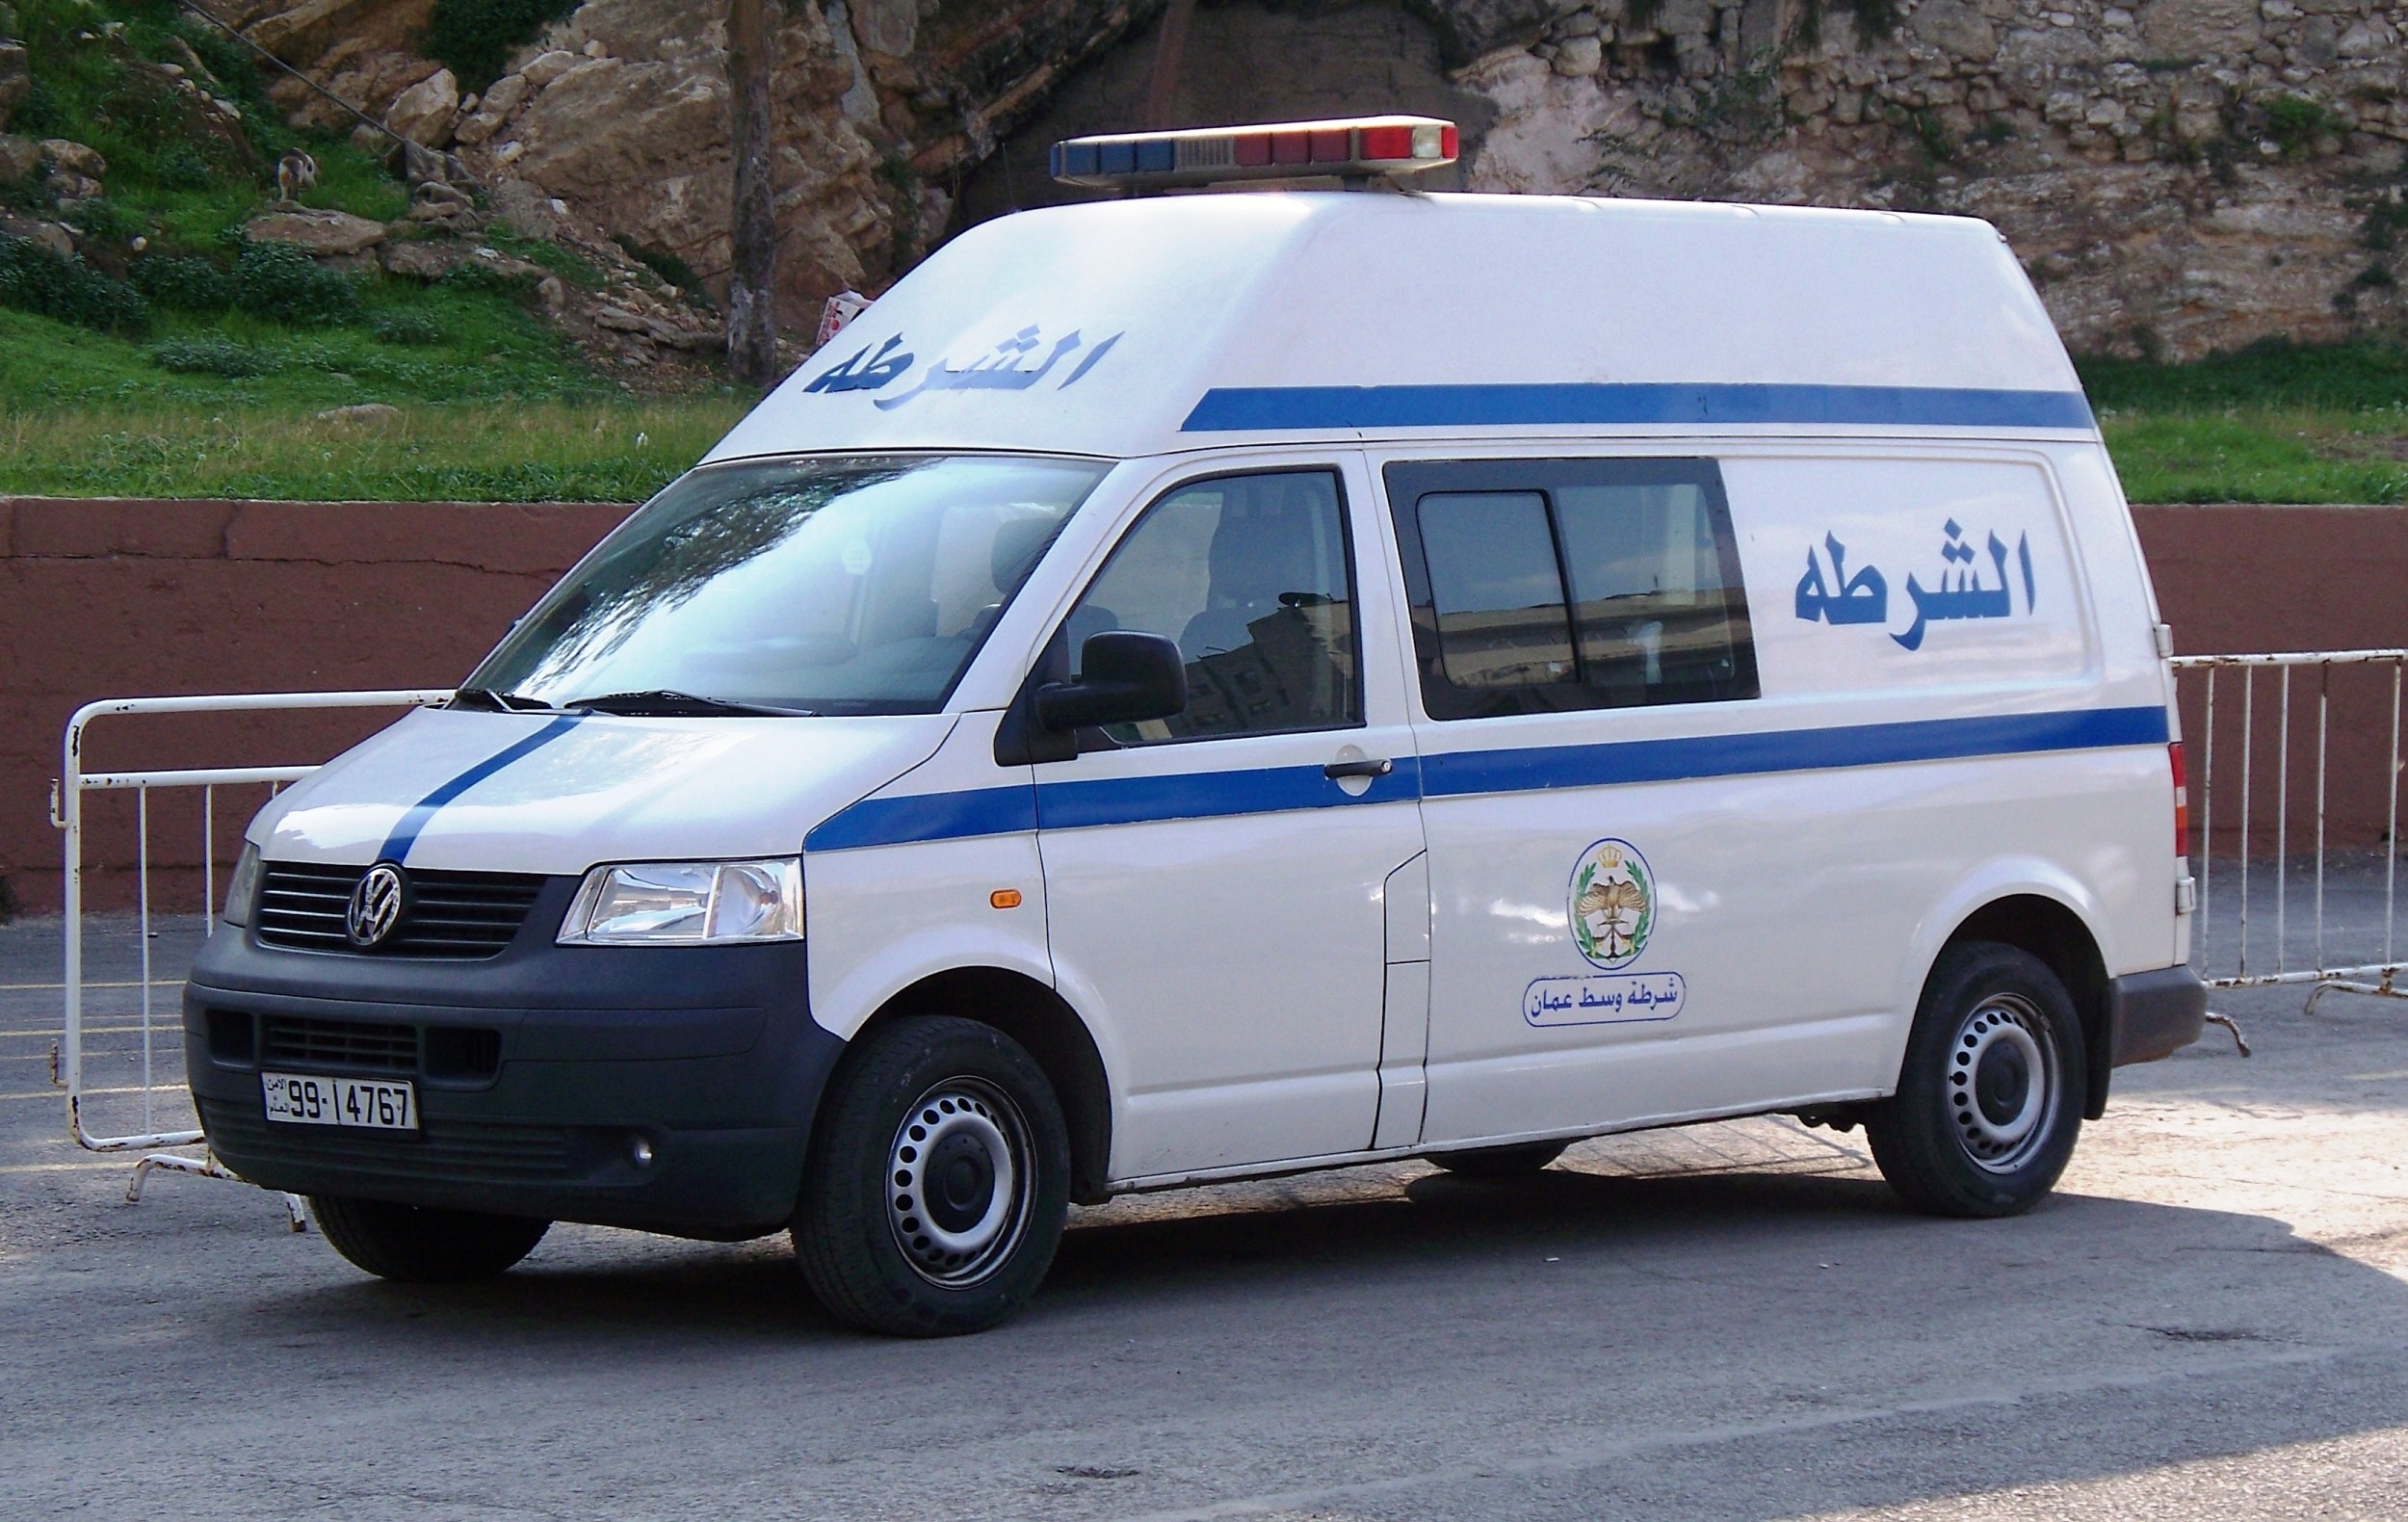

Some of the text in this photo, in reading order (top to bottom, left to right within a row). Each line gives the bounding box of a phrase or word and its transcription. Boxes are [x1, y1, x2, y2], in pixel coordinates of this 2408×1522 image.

[352, 868, 401, 945] VW
[1531, 989, 1573, 1018] عمان
[1579, 986, 1623, 1012] وسط
